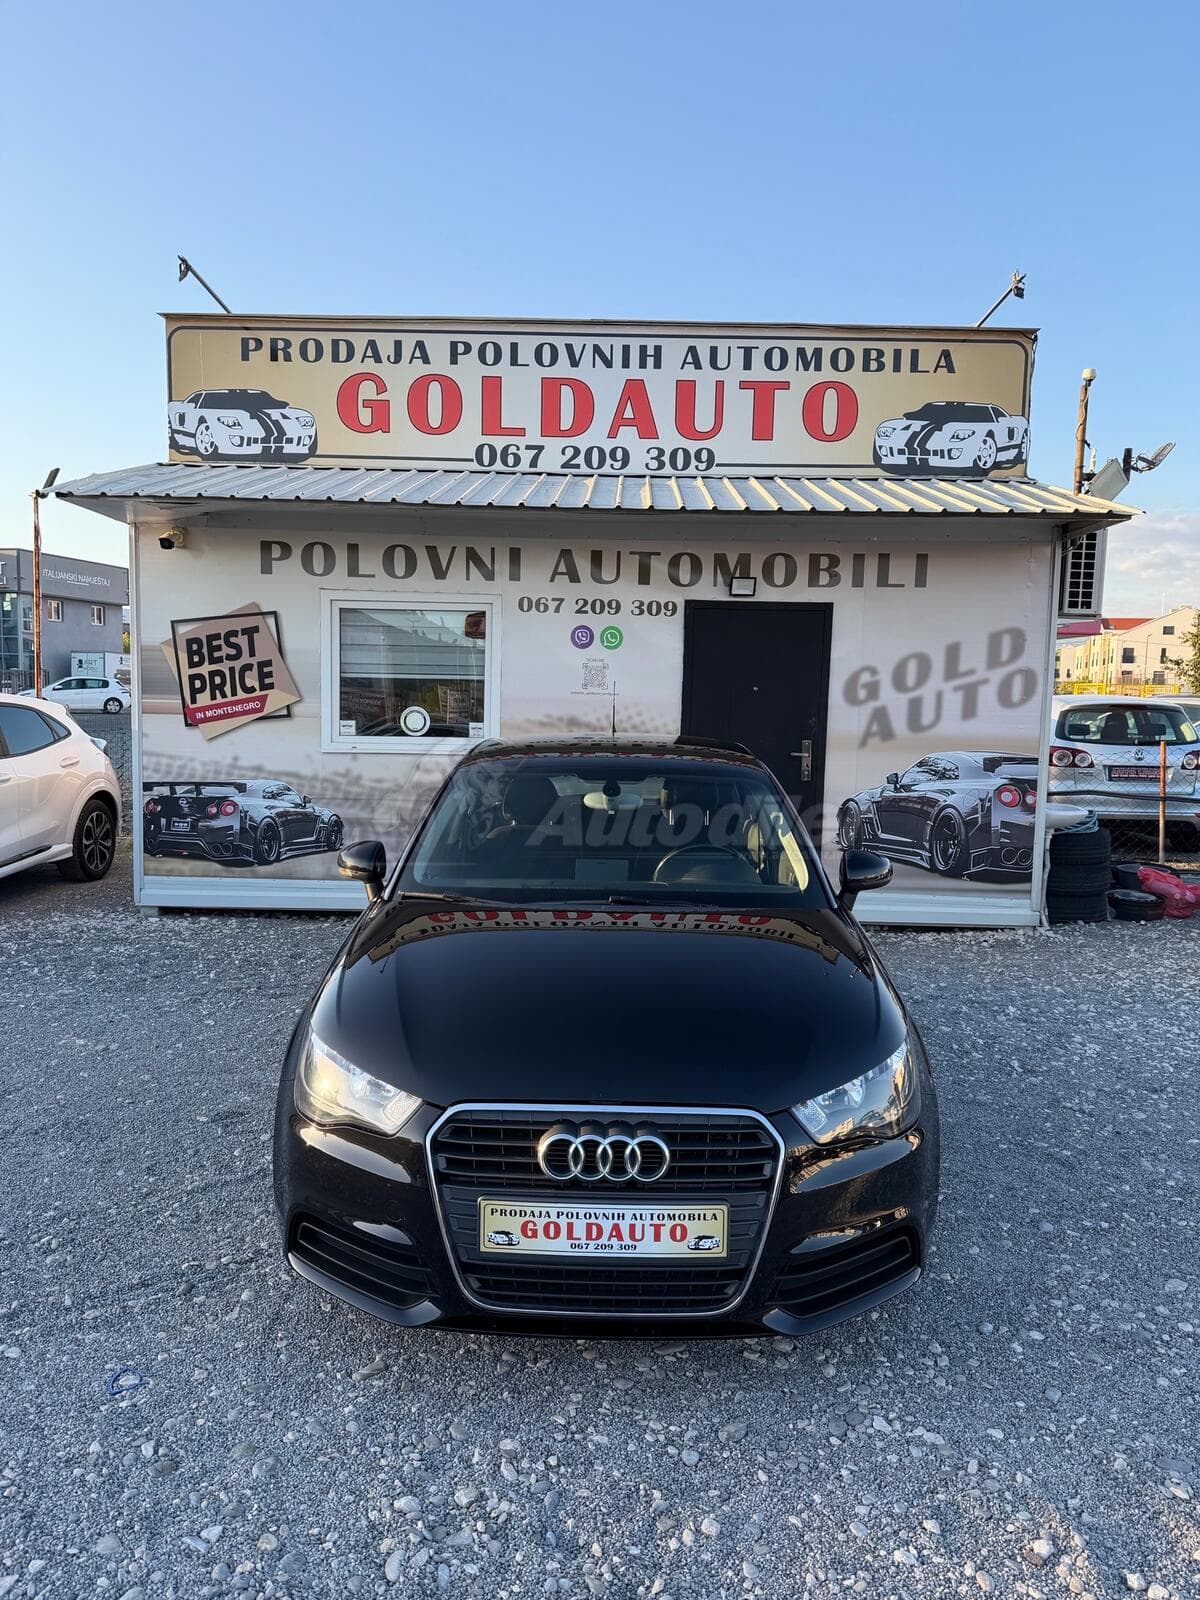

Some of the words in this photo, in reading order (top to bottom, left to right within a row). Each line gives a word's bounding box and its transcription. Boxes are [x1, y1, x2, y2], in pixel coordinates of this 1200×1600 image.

[240, 336, 431, 365] PRODAJA
[449, 340, 663, 369] POLOVNIH
[680, 345, 956, 374] AUTOMOBILA
[336, 372, 859, 443] GOLDAUTO
[474, 443, 545, 469] 067
[559, 445, 631, 471] 209
[644, 446, 716, 472] 309
[259, 540, 522, 582] POLOVNI
[549, 548, 929, 588] AUTOMOBILI
[517, 596, 565, 614] 067
[574, 598, 622, 616] 209
[630, 599, 678, 617] 309
[185, 625, 260, 669] BEST
[187, 659, 275, 705] PRICE
[842, 626, 1027, 707] GOLD
[195, 711, 204, 720] IN
[205, 700, 261, 718] MONTENEGRO
[857, 667, 1039, 749] AUTO
[490, 1207, 552, 1219] PRODAJA
[556, 1210, 626, 1221] POLOVNIH
[630, 1212, 719, 1222] AUTOMOBILA
[520, 1220, 688, 1243] GOLDAUTO
[570, 1242, 591, 1250] 067
[593, 1243, 614, 1251] 209
[616, 1243, 637, 1252] 309
